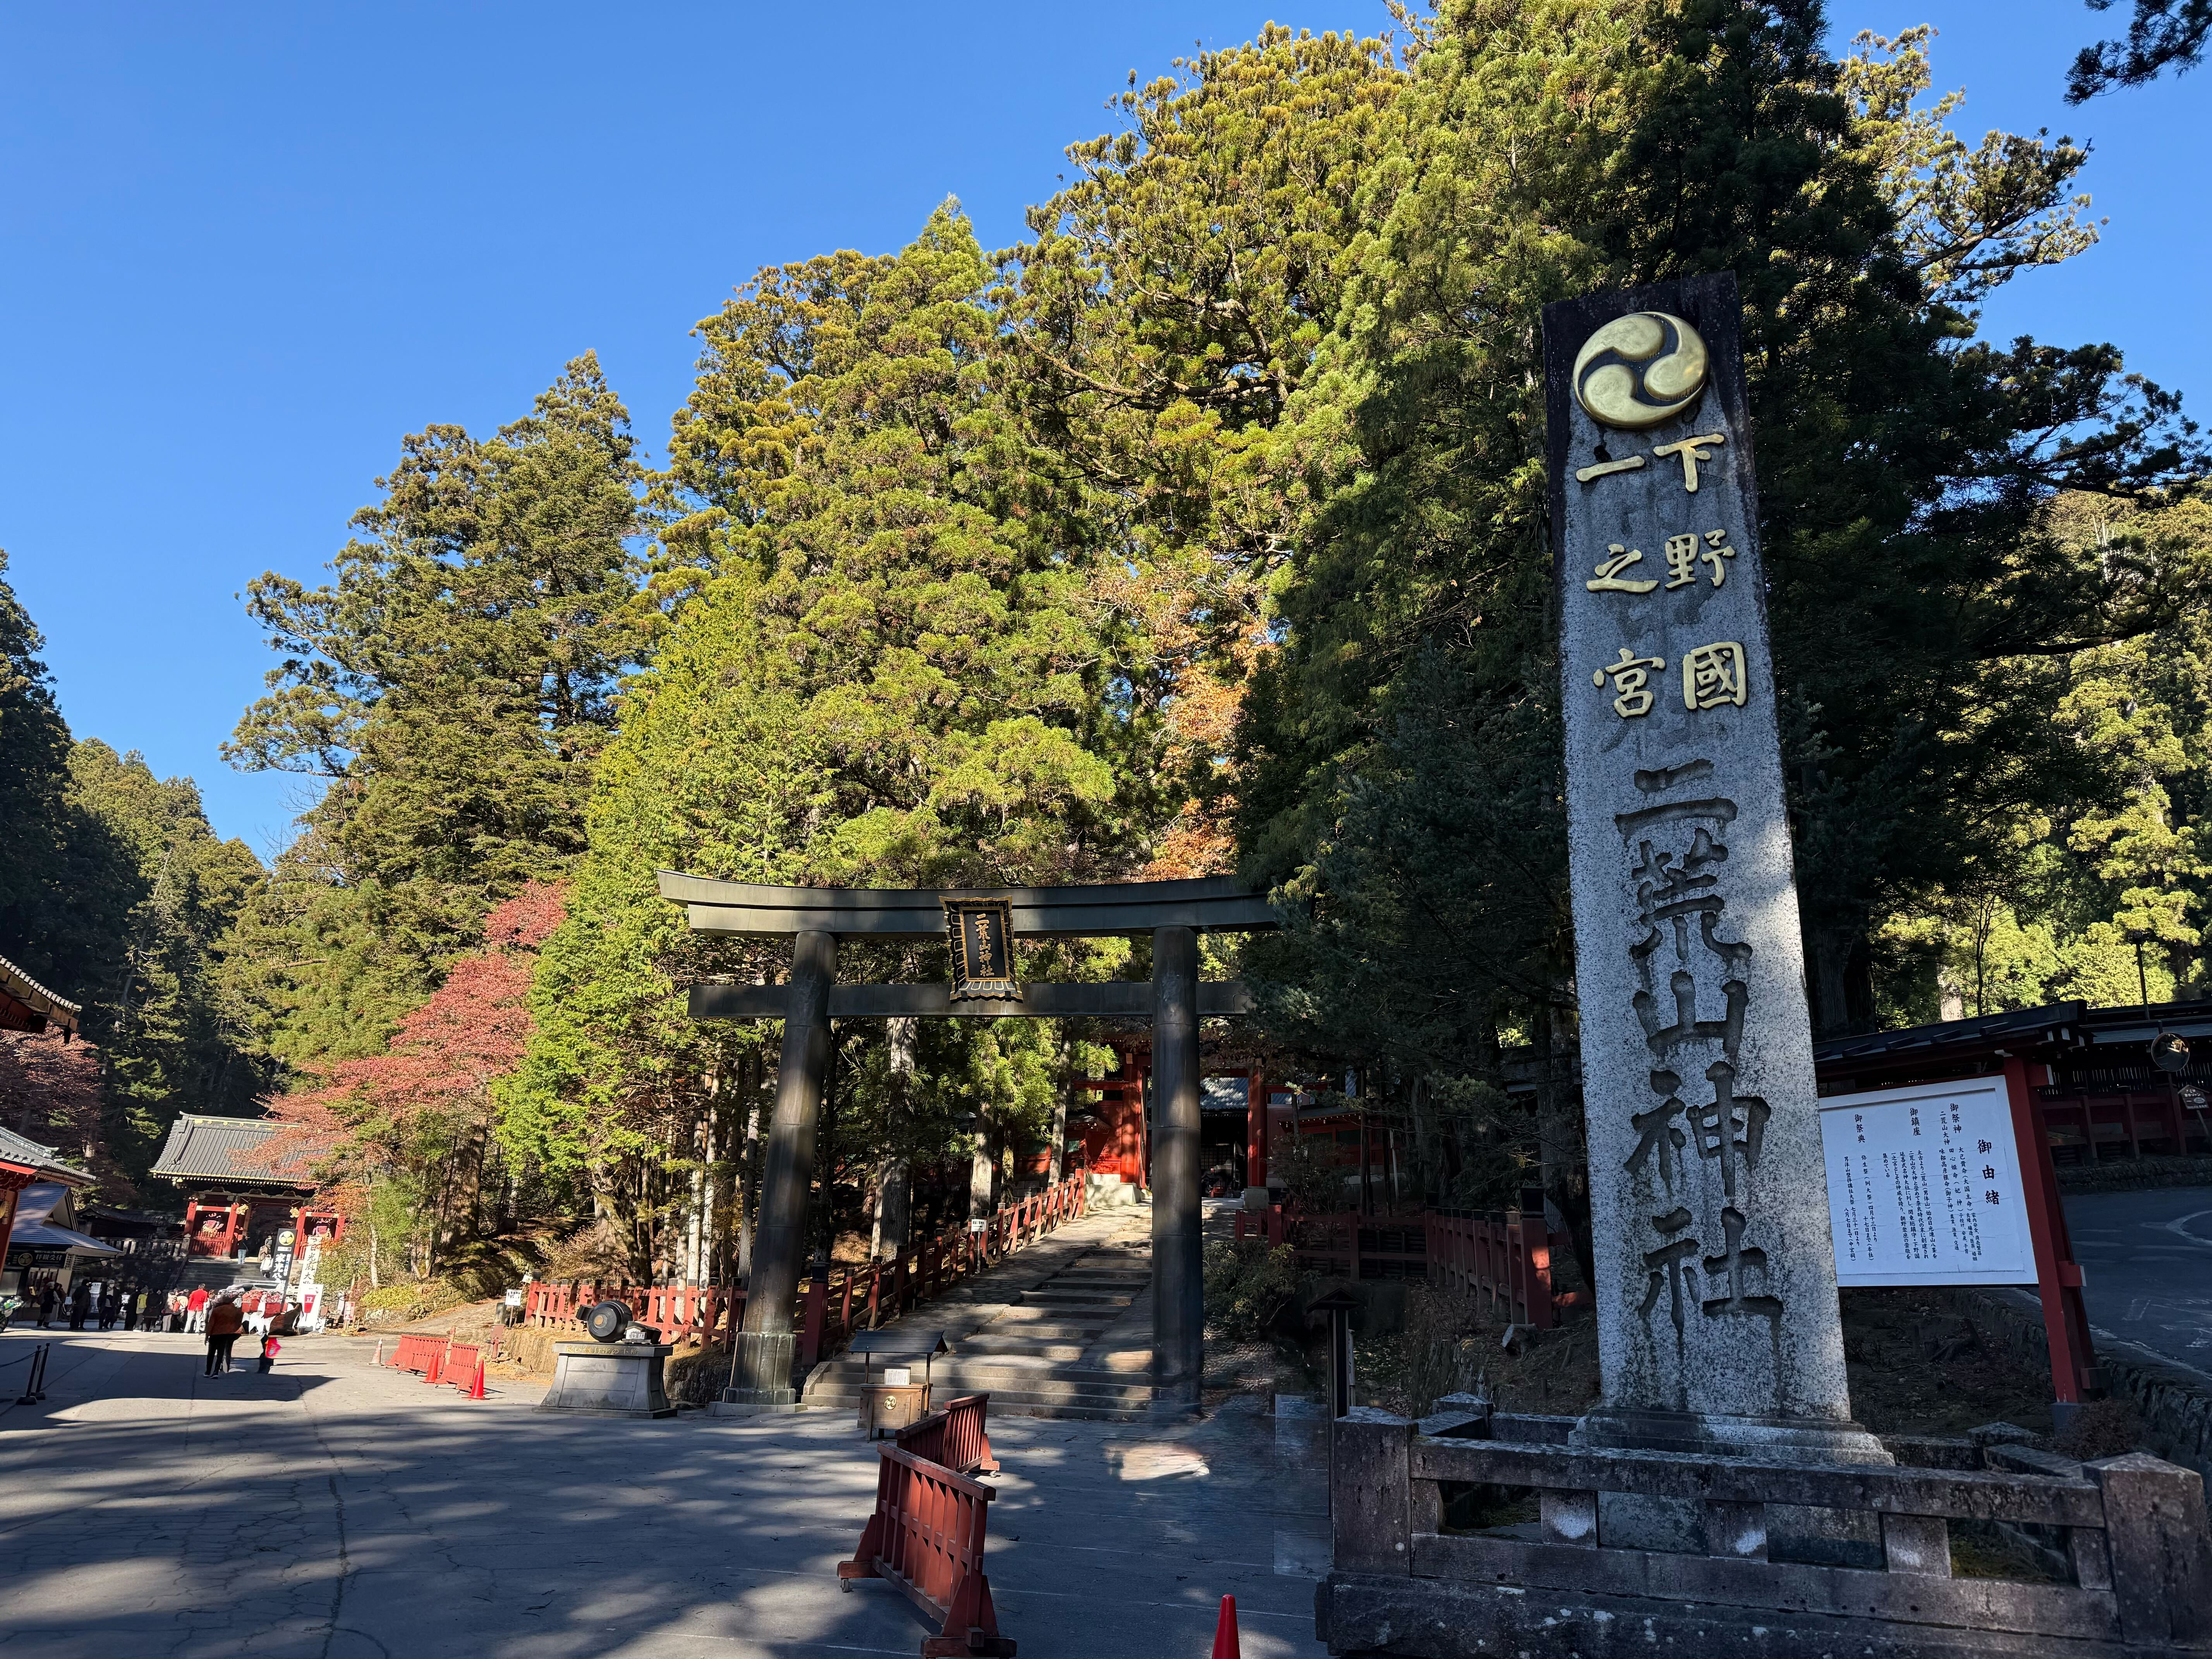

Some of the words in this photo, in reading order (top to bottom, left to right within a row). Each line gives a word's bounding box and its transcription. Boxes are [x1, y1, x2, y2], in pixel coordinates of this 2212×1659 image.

[1576, 455, 1666, 718] 一之宮
[1654, 433, 1748, 710] 下野國
[975, 914, 994, 977] 二荒山神社
[1614, 758, 1784, 1338] 二荒山神社
[1855, 1114, 1865, 1143] 御祭典
[1910, 1108, 1921, 1136] 御鎮座
[1940, 1111, 1950, 1145] 二荒山大神
[1950, 1103, 1961, 1133] 御祭神
[1977, 1139, 1999, 1205] 御由緒
